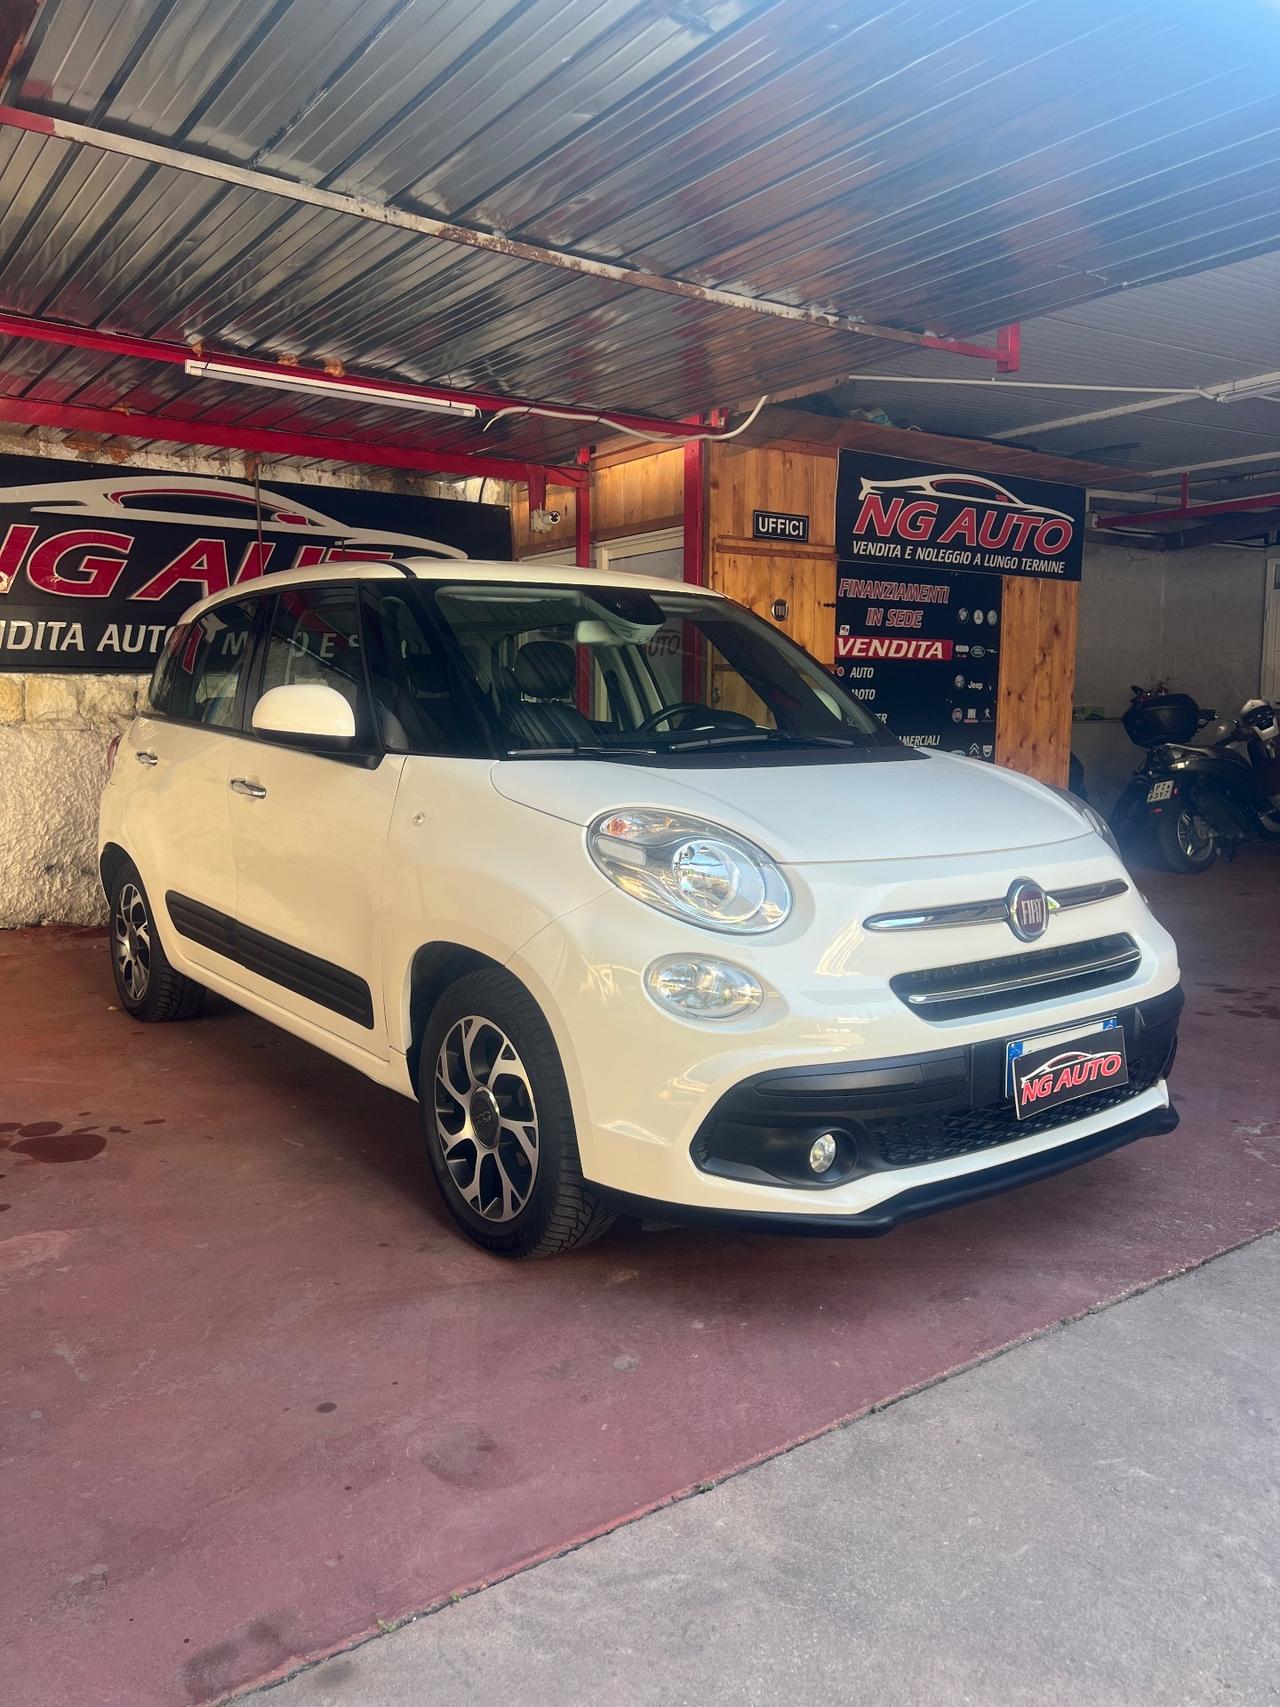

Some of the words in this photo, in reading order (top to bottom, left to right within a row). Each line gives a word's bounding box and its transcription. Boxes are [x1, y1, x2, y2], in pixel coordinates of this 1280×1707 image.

[758, 516, 804, 537] UFFICI
[853, 494, 940, 541] NG
[937, 507, 1074, 556] AUTO
[852, 540, 902, 559] VENDITA
[904, 546, 913, 559] E
[916, 547, 972, 566] NOLEGGIO
[973, 553, 982, 566] A
[983, 554, 1018, 570] LUNGO
[1020, 557, 1066, 574] TERMINE
[838, 578, 951, 604] FINANZIAMENTI
[865, 607, 884, 627] IN
[885, 609, 924, 629] SEDE
[0, 619, 86, 652] DITA
[836, 637, 943, 659] VENDITA
[850, 666, 874, 679] AUTO
[898, 734, 941, 747] MERCIALI
[1021, 1073, 1054, 1106] NG
[1053, 1054, 1122, 1093] AUTO
